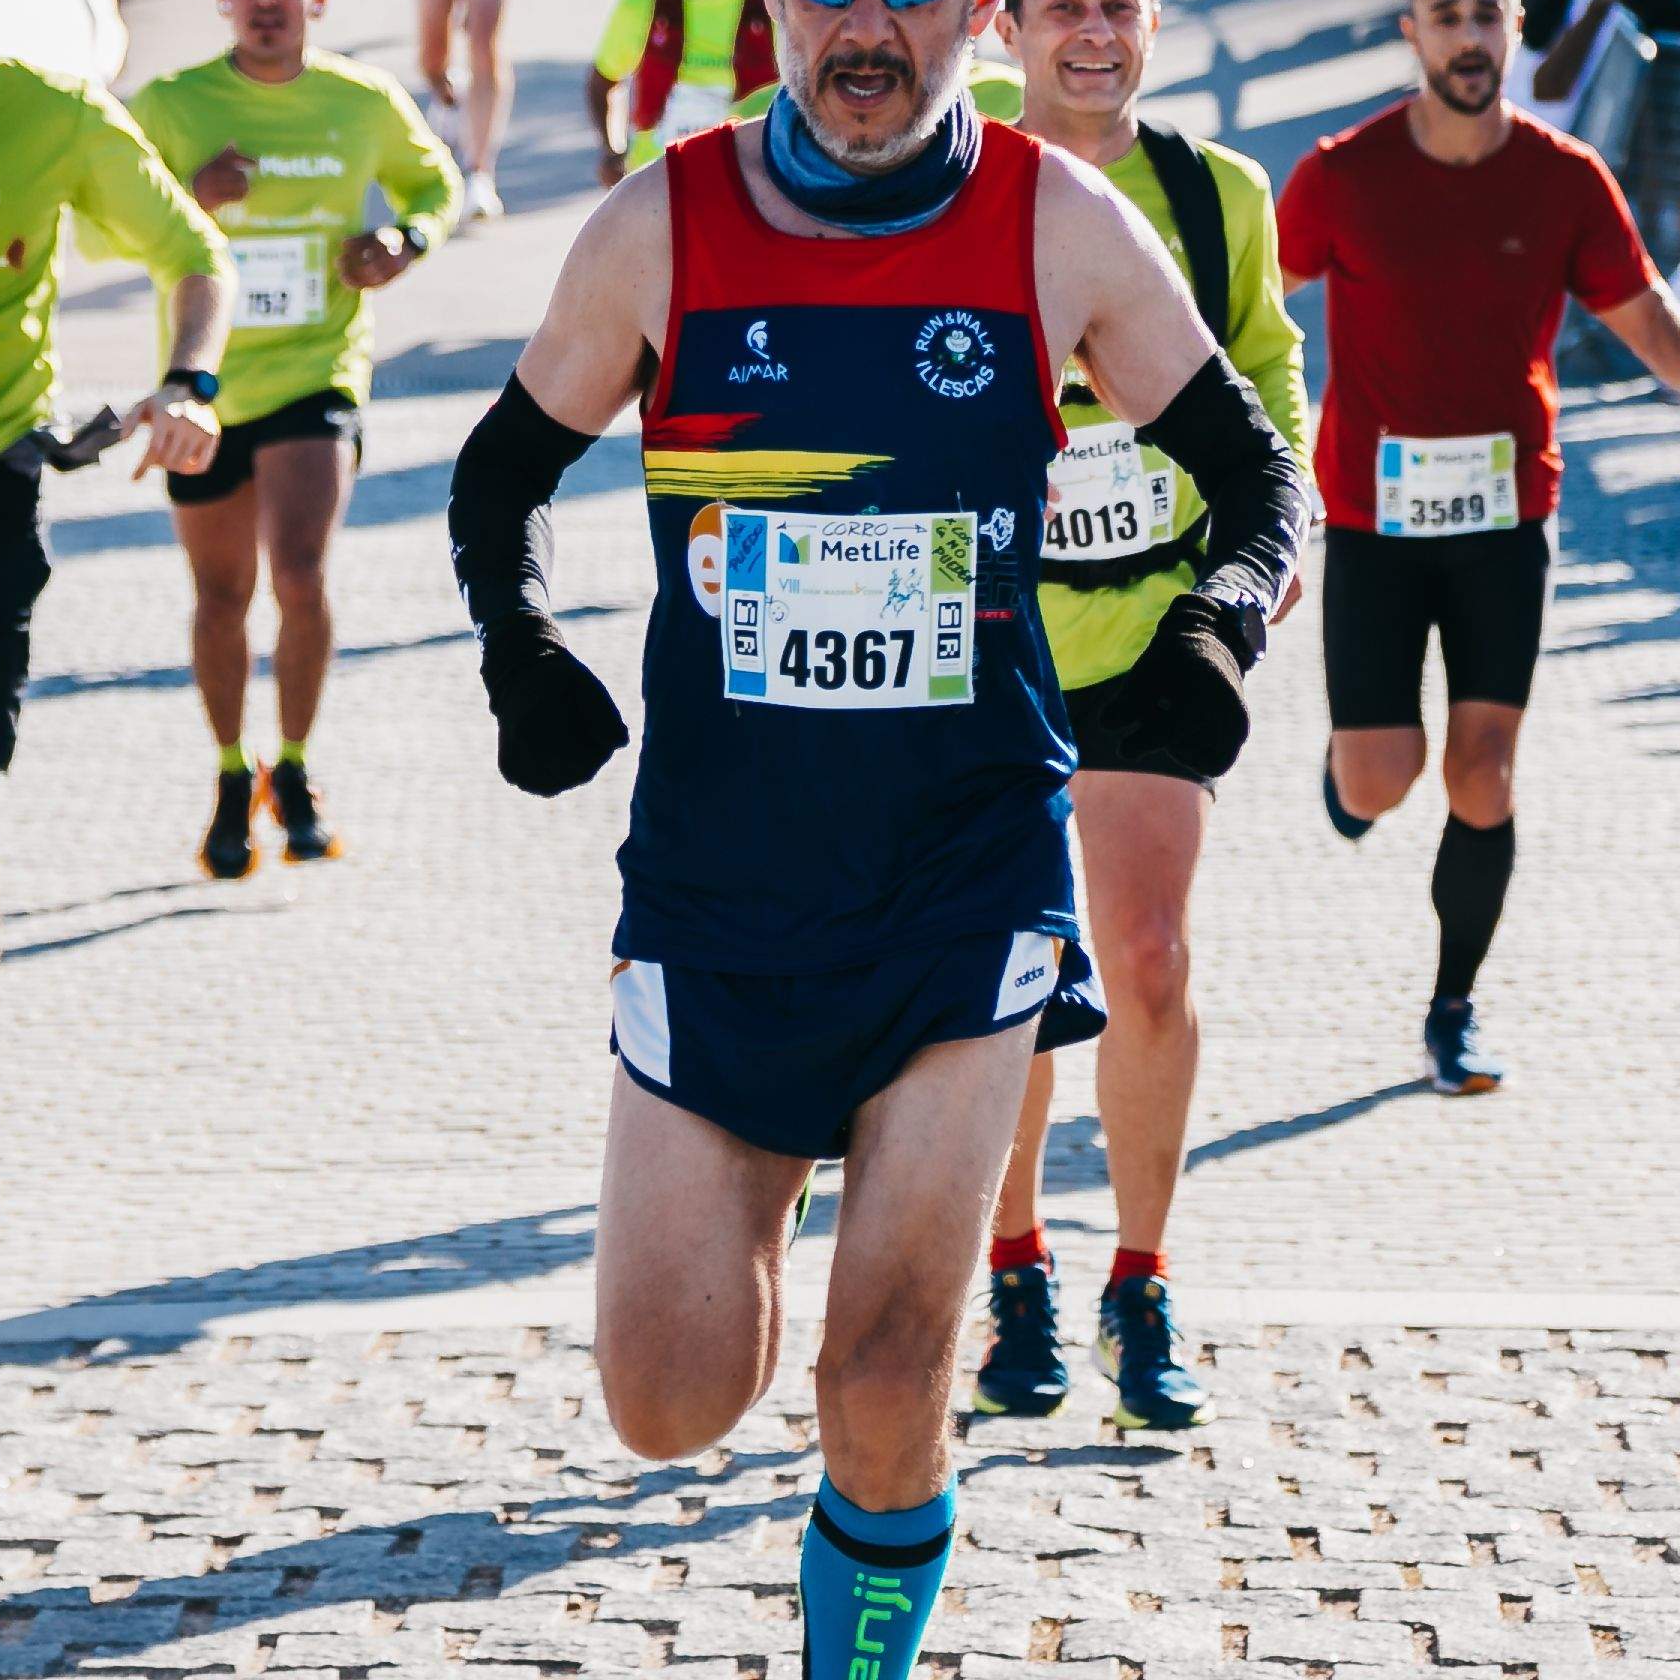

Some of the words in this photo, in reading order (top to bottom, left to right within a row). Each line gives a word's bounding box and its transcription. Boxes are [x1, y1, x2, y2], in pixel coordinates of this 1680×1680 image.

[728, 363, 790, 383] AIMAR
[916, 360, 995, 398] ILLESCAS
[1062, 439, 1131, 461] MetLife
[822, 521, 888, 536] CORRO
[1046, 500, 1138, 550] 4013
[820, 539, 920, 562] MetLife
[779, 629, 915, 690] 4367
